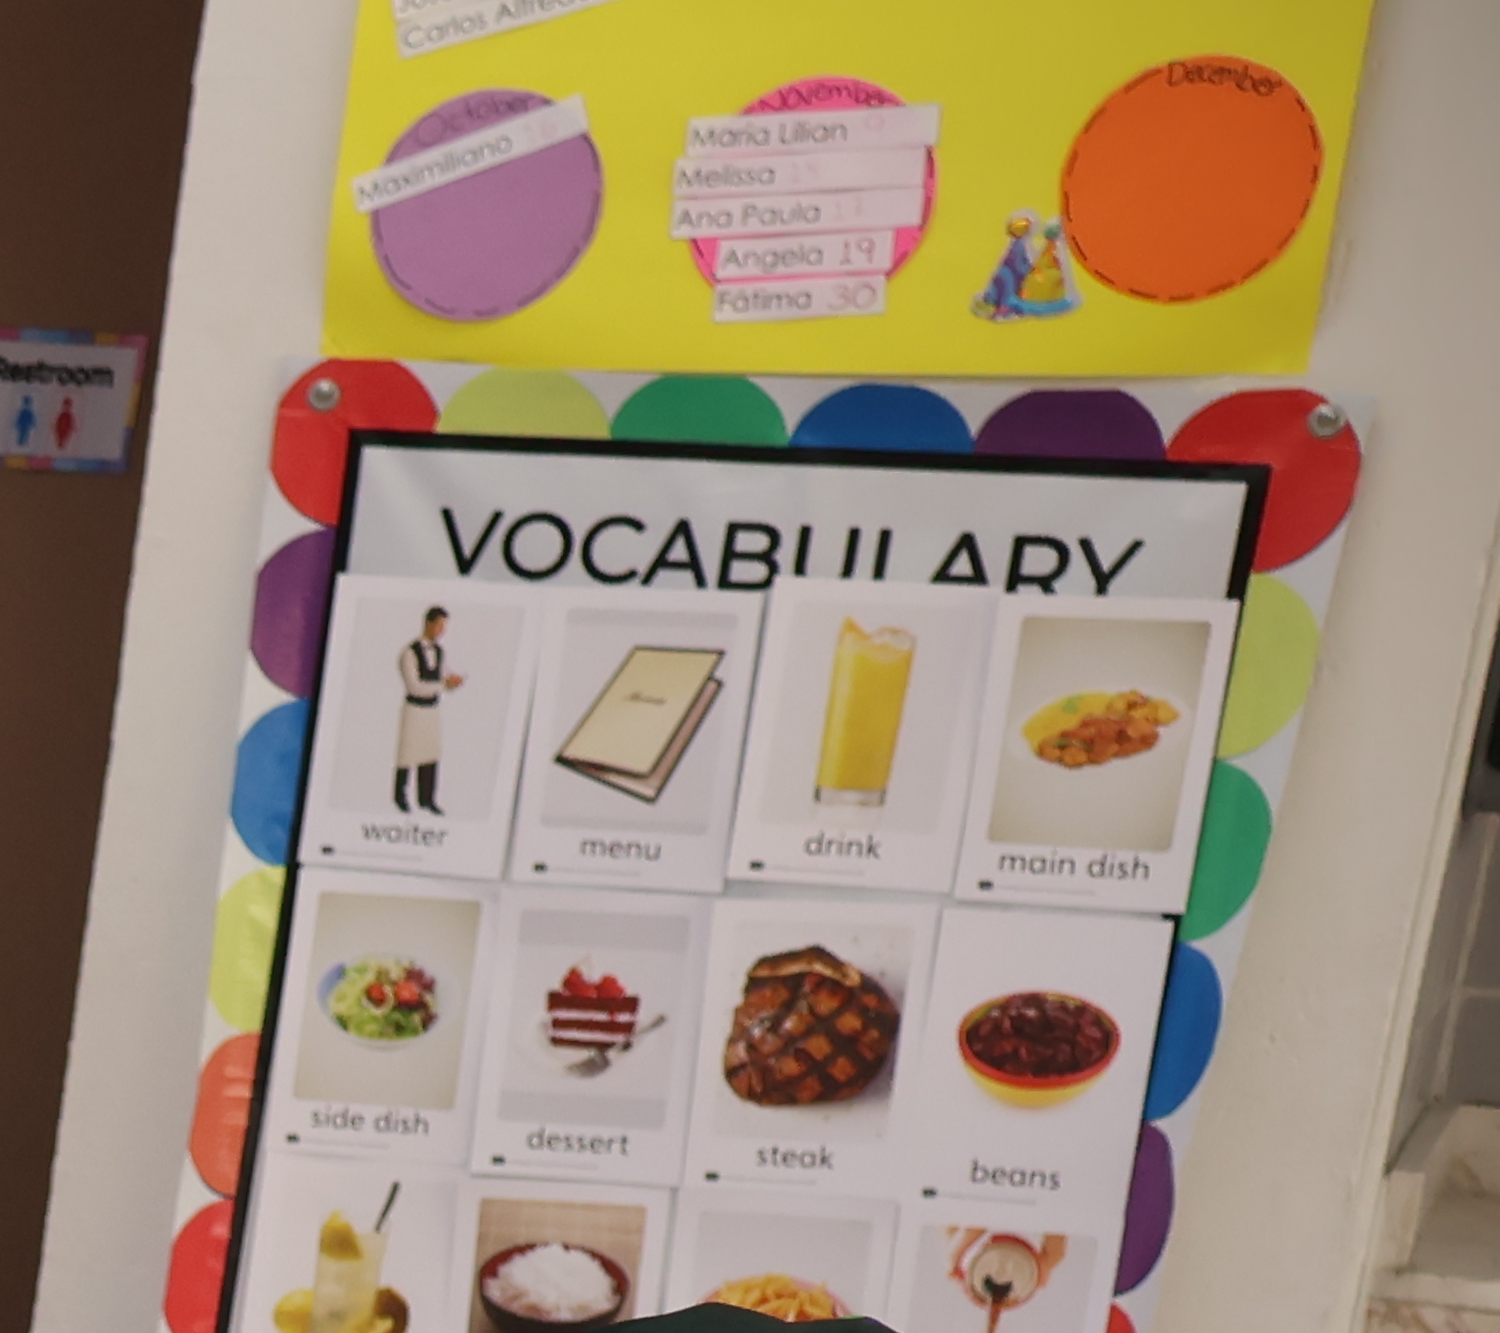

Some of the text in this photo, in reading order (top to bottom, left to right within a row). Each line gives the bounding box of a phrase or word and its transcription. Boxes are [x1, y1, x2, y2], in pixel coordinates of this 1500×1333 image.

[403, 13, 487, 49] Carlos
[358, 136, 513, 201] Maximiliano
[677, 164, 776, 189] Melissa
[676, 206, 734, 229] Ana
[741, 200, 822, 226] Paula
[723, 236, 877, 273] Angela 19
[827, 281, 878, 311] 30
[361, 822, 449, 848] waiter
[579, 836, 662, 862] menu
[803, 830, 881, 860] drink
[998, 850, 1151, 881] main dish
[310, 1105, 430, 1136] side dish
[526, 1127, 630, 1156] dessert
[755, 1144, 835, 1171] steak
[970, 1158, 1062, 1191] beans
